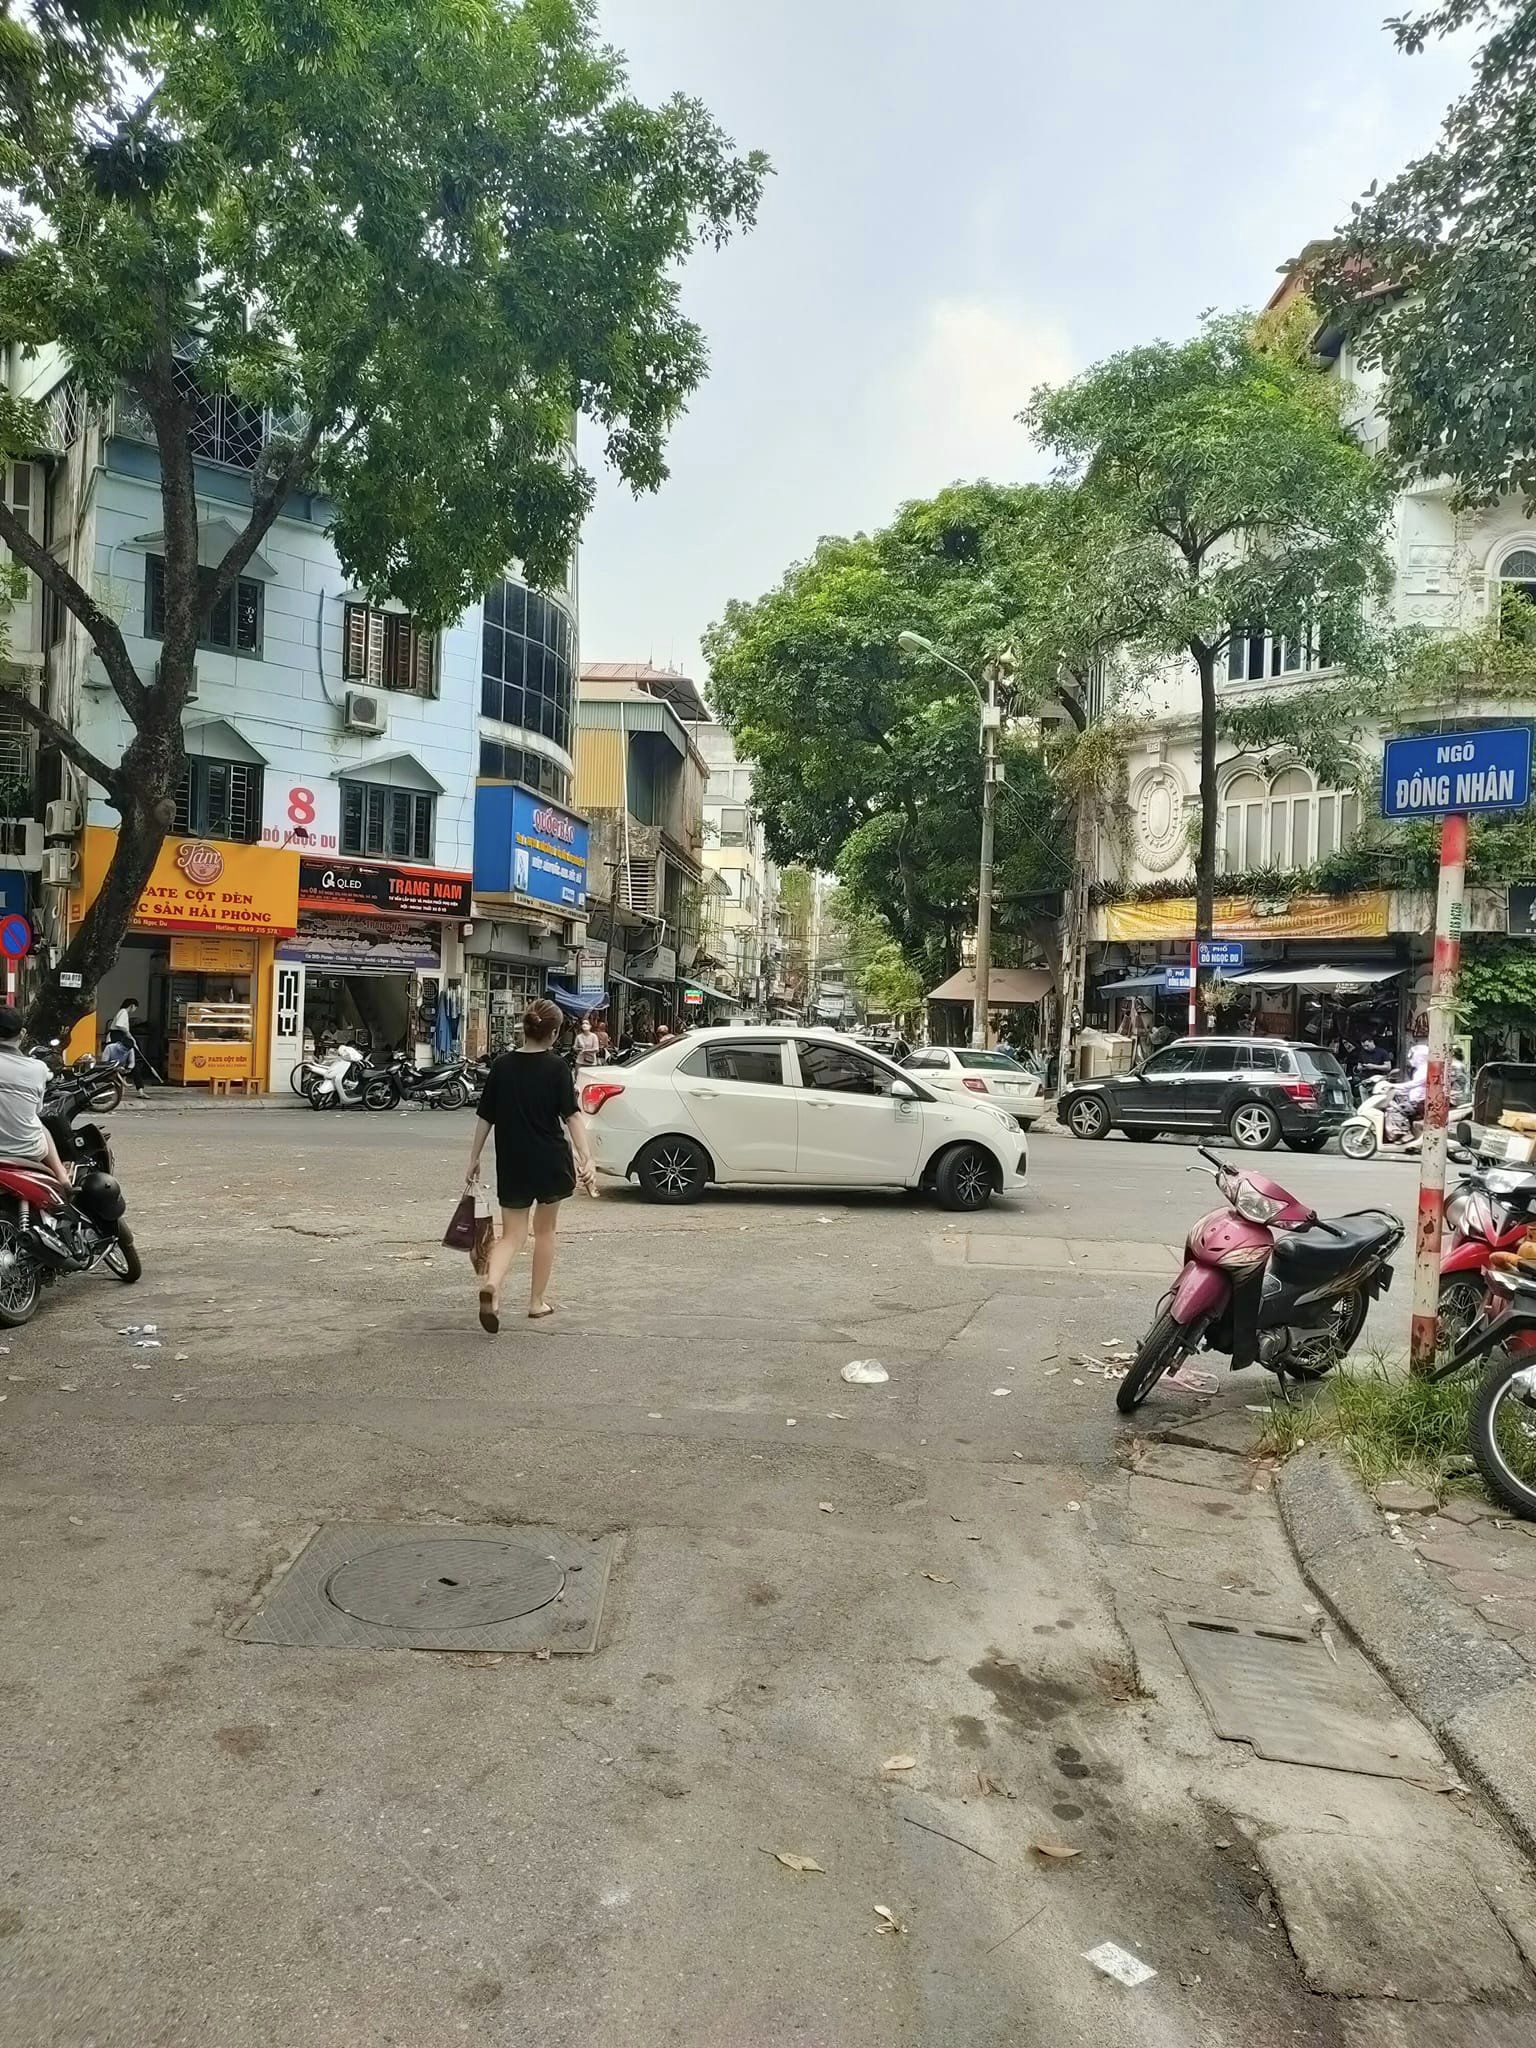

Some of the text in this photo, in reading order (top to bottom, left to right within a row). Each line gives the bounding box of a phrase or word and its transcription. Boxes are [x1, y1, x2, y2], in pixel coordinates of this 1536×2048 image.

[1436, 741, 1475, 764] NGÕ
[1396, 764, 1515, 809] ĐỒNG NHÂN
[287, 787, 316, 825] 8
[320, 834, 336, 849] DU
[337, 878, 362, 890] QLED
[389, 878, 463, 900] TRANG NAM
[184, 888, 216, 905] CỘT
[221, 892, 254, 905] ĐÈN
[153, 901, 184, 917] SẢN
[189, 904, 217, 919] HẢI
[221, 908, 272, 923] PHÒNG
